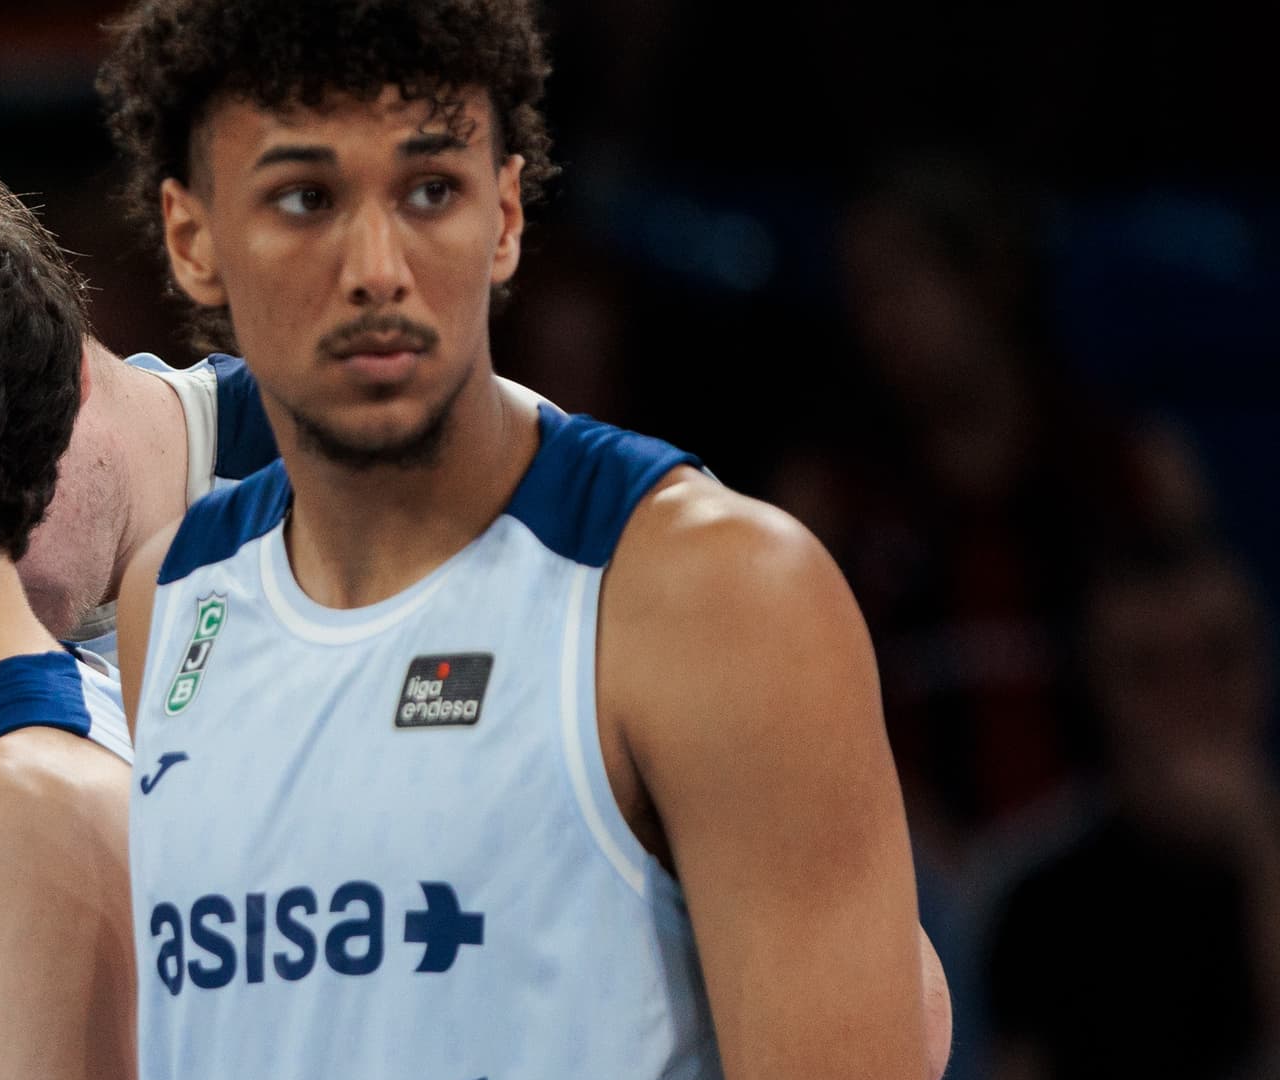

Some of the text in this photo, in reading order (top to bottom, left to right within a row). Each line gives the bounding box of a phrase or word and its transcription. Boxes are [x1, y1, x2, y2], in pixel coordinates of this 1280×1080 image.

[170, 606, 221, 703] CJB
[401, 696, 480, 721] endesa
[406, 675, 444, 701] liga
[150, 880, 385, 996] asisa
